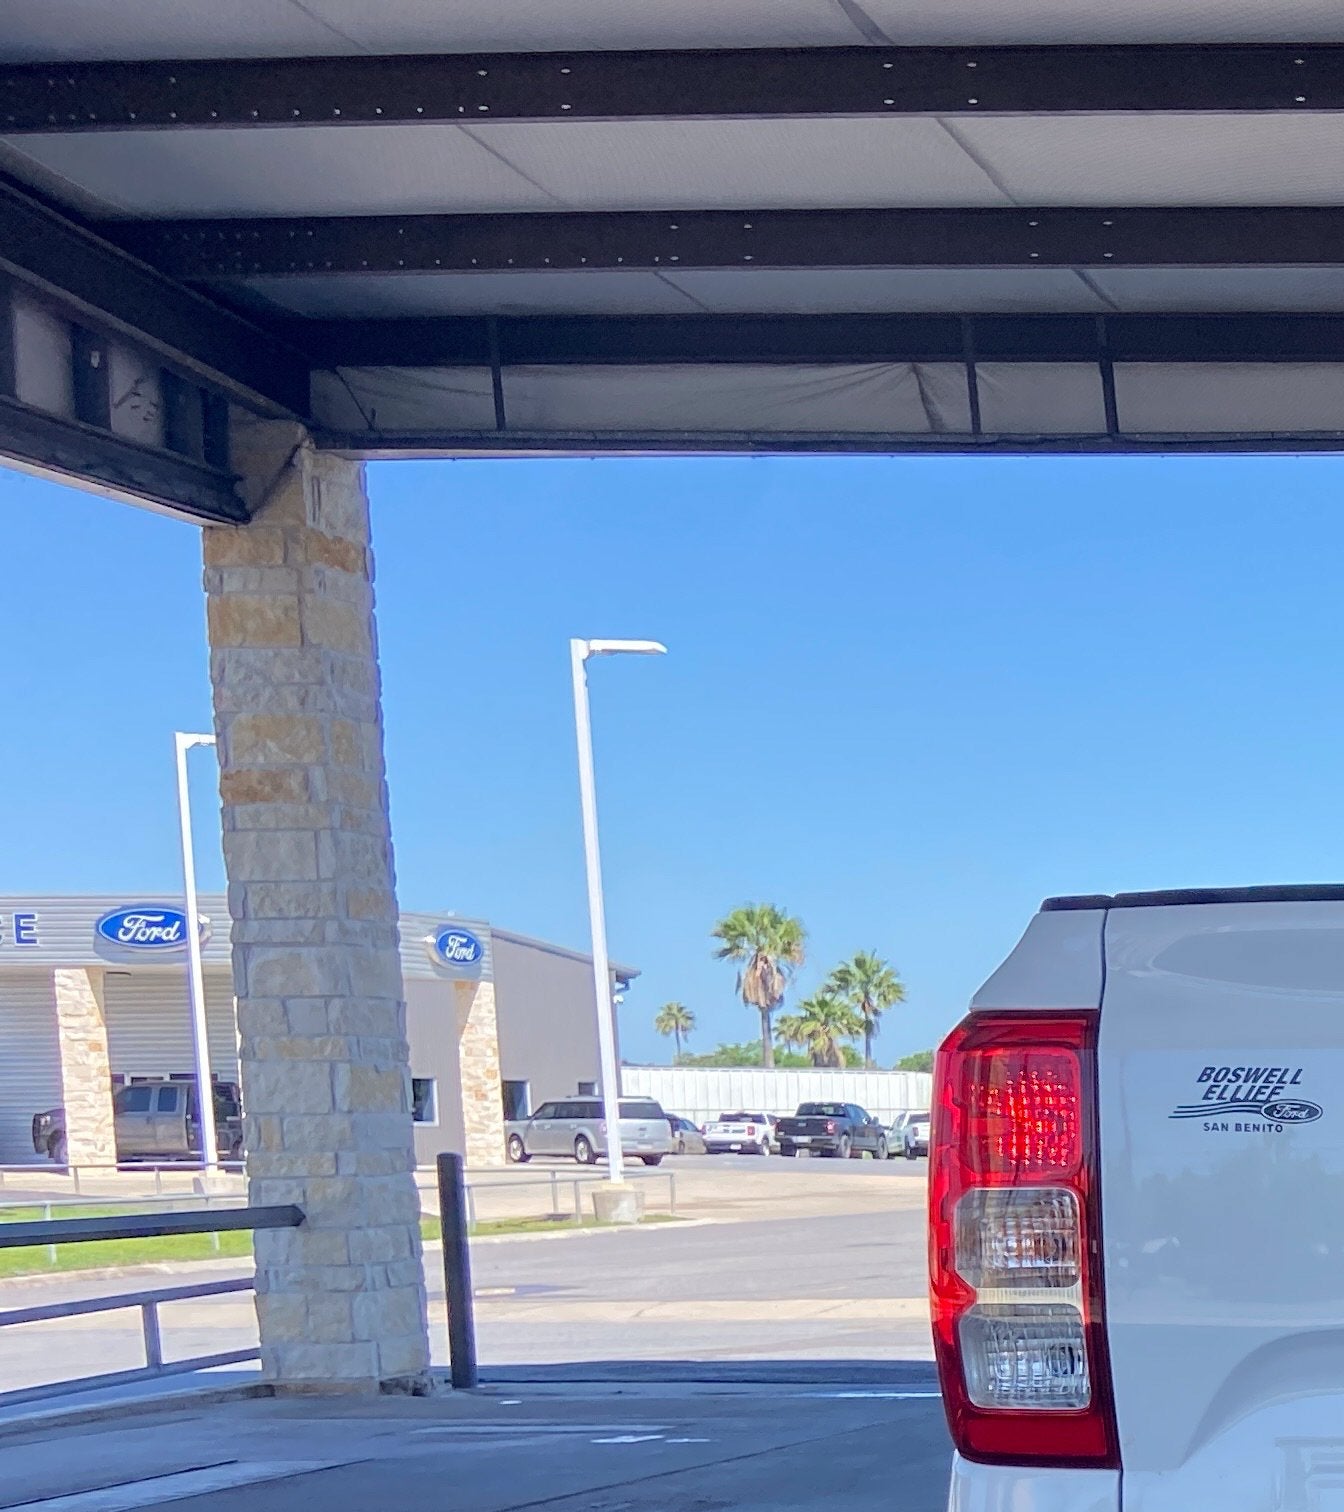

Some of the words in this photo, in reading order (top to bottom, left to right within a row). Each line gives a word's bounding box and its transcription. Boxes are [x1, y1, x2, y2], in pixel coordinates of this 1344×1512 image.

[0, 913, 39, 947] E
[118, 915, 181, 942] Ford
[446, 935, 476, 961] Ford
[1196, 1066, 1303, 1085] BOSWELL
[1201, 1084, 1285, 1102] ELLIFF
[1272, 1103, 1310, 1119] Ford
[1203, 1122, 1229, 1132] SAN
[1234, 1122, 1284, 1133] BENITO
